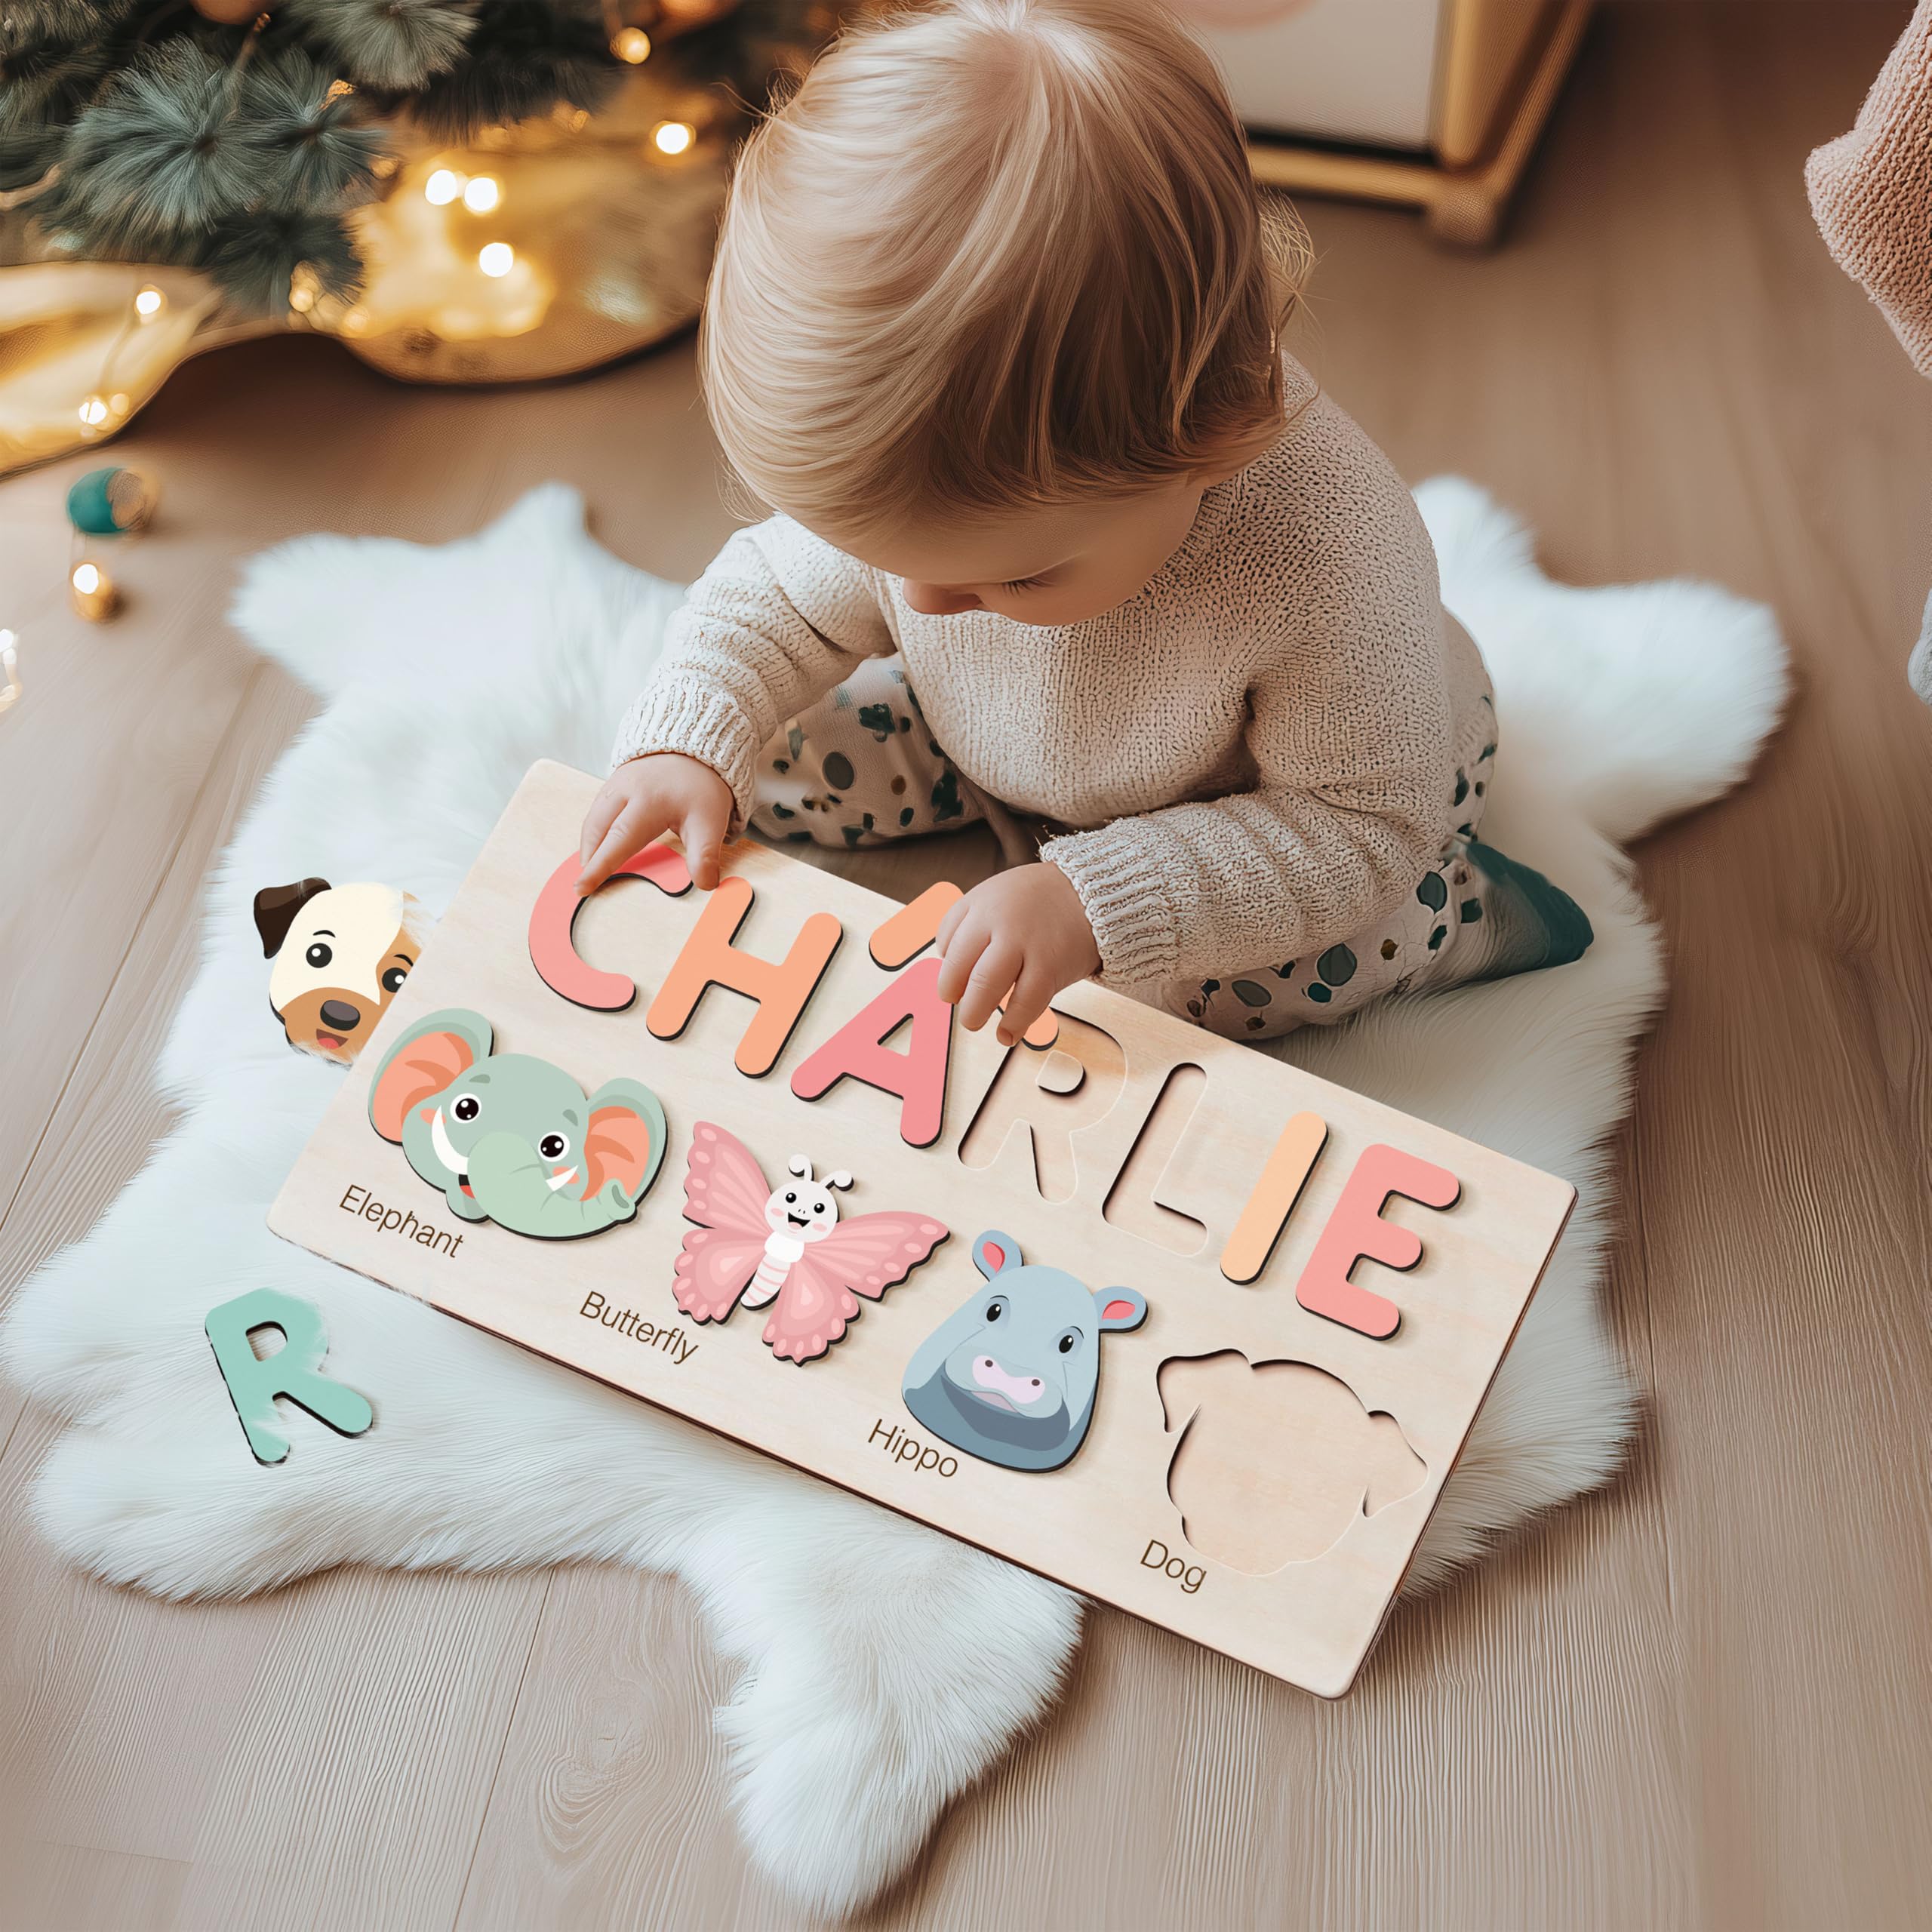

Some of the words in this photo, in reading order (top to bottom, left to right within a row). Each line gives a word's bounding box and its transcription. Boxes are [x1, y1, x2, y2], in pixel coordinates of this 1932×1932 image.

[528, 841, 1462, 1341] CHARLIE
[339, 1183, 464, 1259] Elephant
[579, 1291, 699, 1365] Butterfly
[205, 1287, 373, 1467] R
[867, 1418, 959, 1478] Hippo
[1140, 1540, 1208, 1594] Dog
